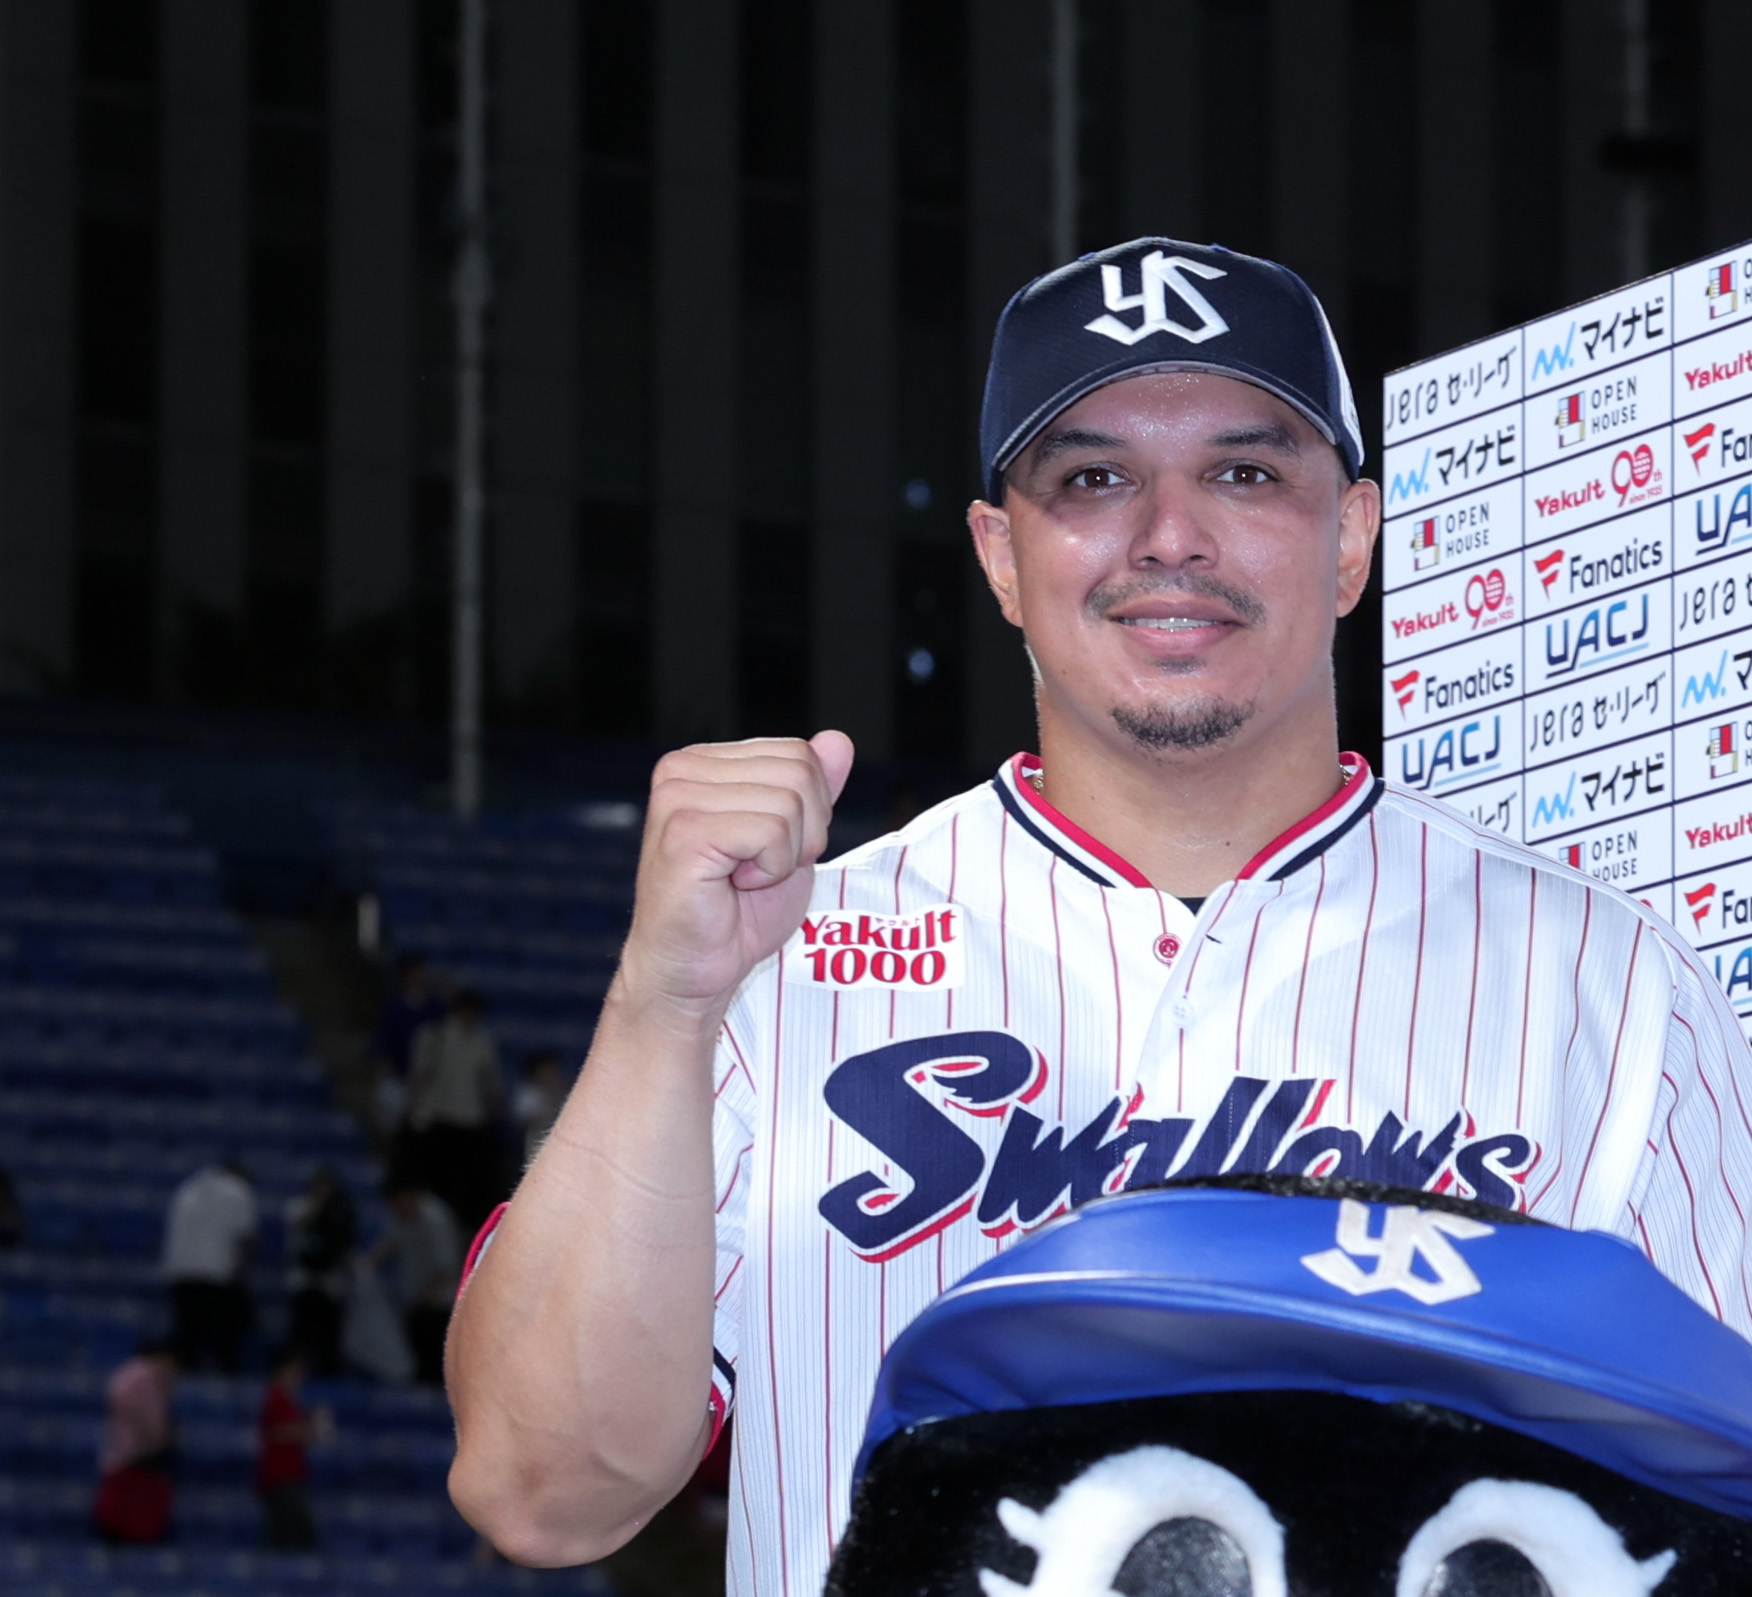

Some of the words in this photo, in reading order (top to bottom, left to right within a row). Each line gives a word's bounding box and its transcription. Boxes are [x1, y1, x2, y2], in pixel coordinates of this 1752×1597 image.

[1581, 297, 1663, 360] マイナビ
[1592, 378, 1636, 409] OPEN
[1592, 404, 1636, 433] HOUSE
[1436, 426, 1515, 485] マイナビ
[1446, 503, 1488, 533] OPEN
[1535, 480, 1604, 517] Yakult
[1447, 529, 1489, 557] HOUSE
[1571, 539, 1662, 592] Fanatics
[1392, 603, 1458, 637] Yakult
[1546, 594, 1648, 679] UACJ
[1426, 661, 1513, 712] Fanatics
[1400, 716, 1500, 798] UACJ
[1582, 753, 1664, 811] マイナビ
[801, 909, 957, 951] Yakult
[804, 948, 946, 985] 1000
